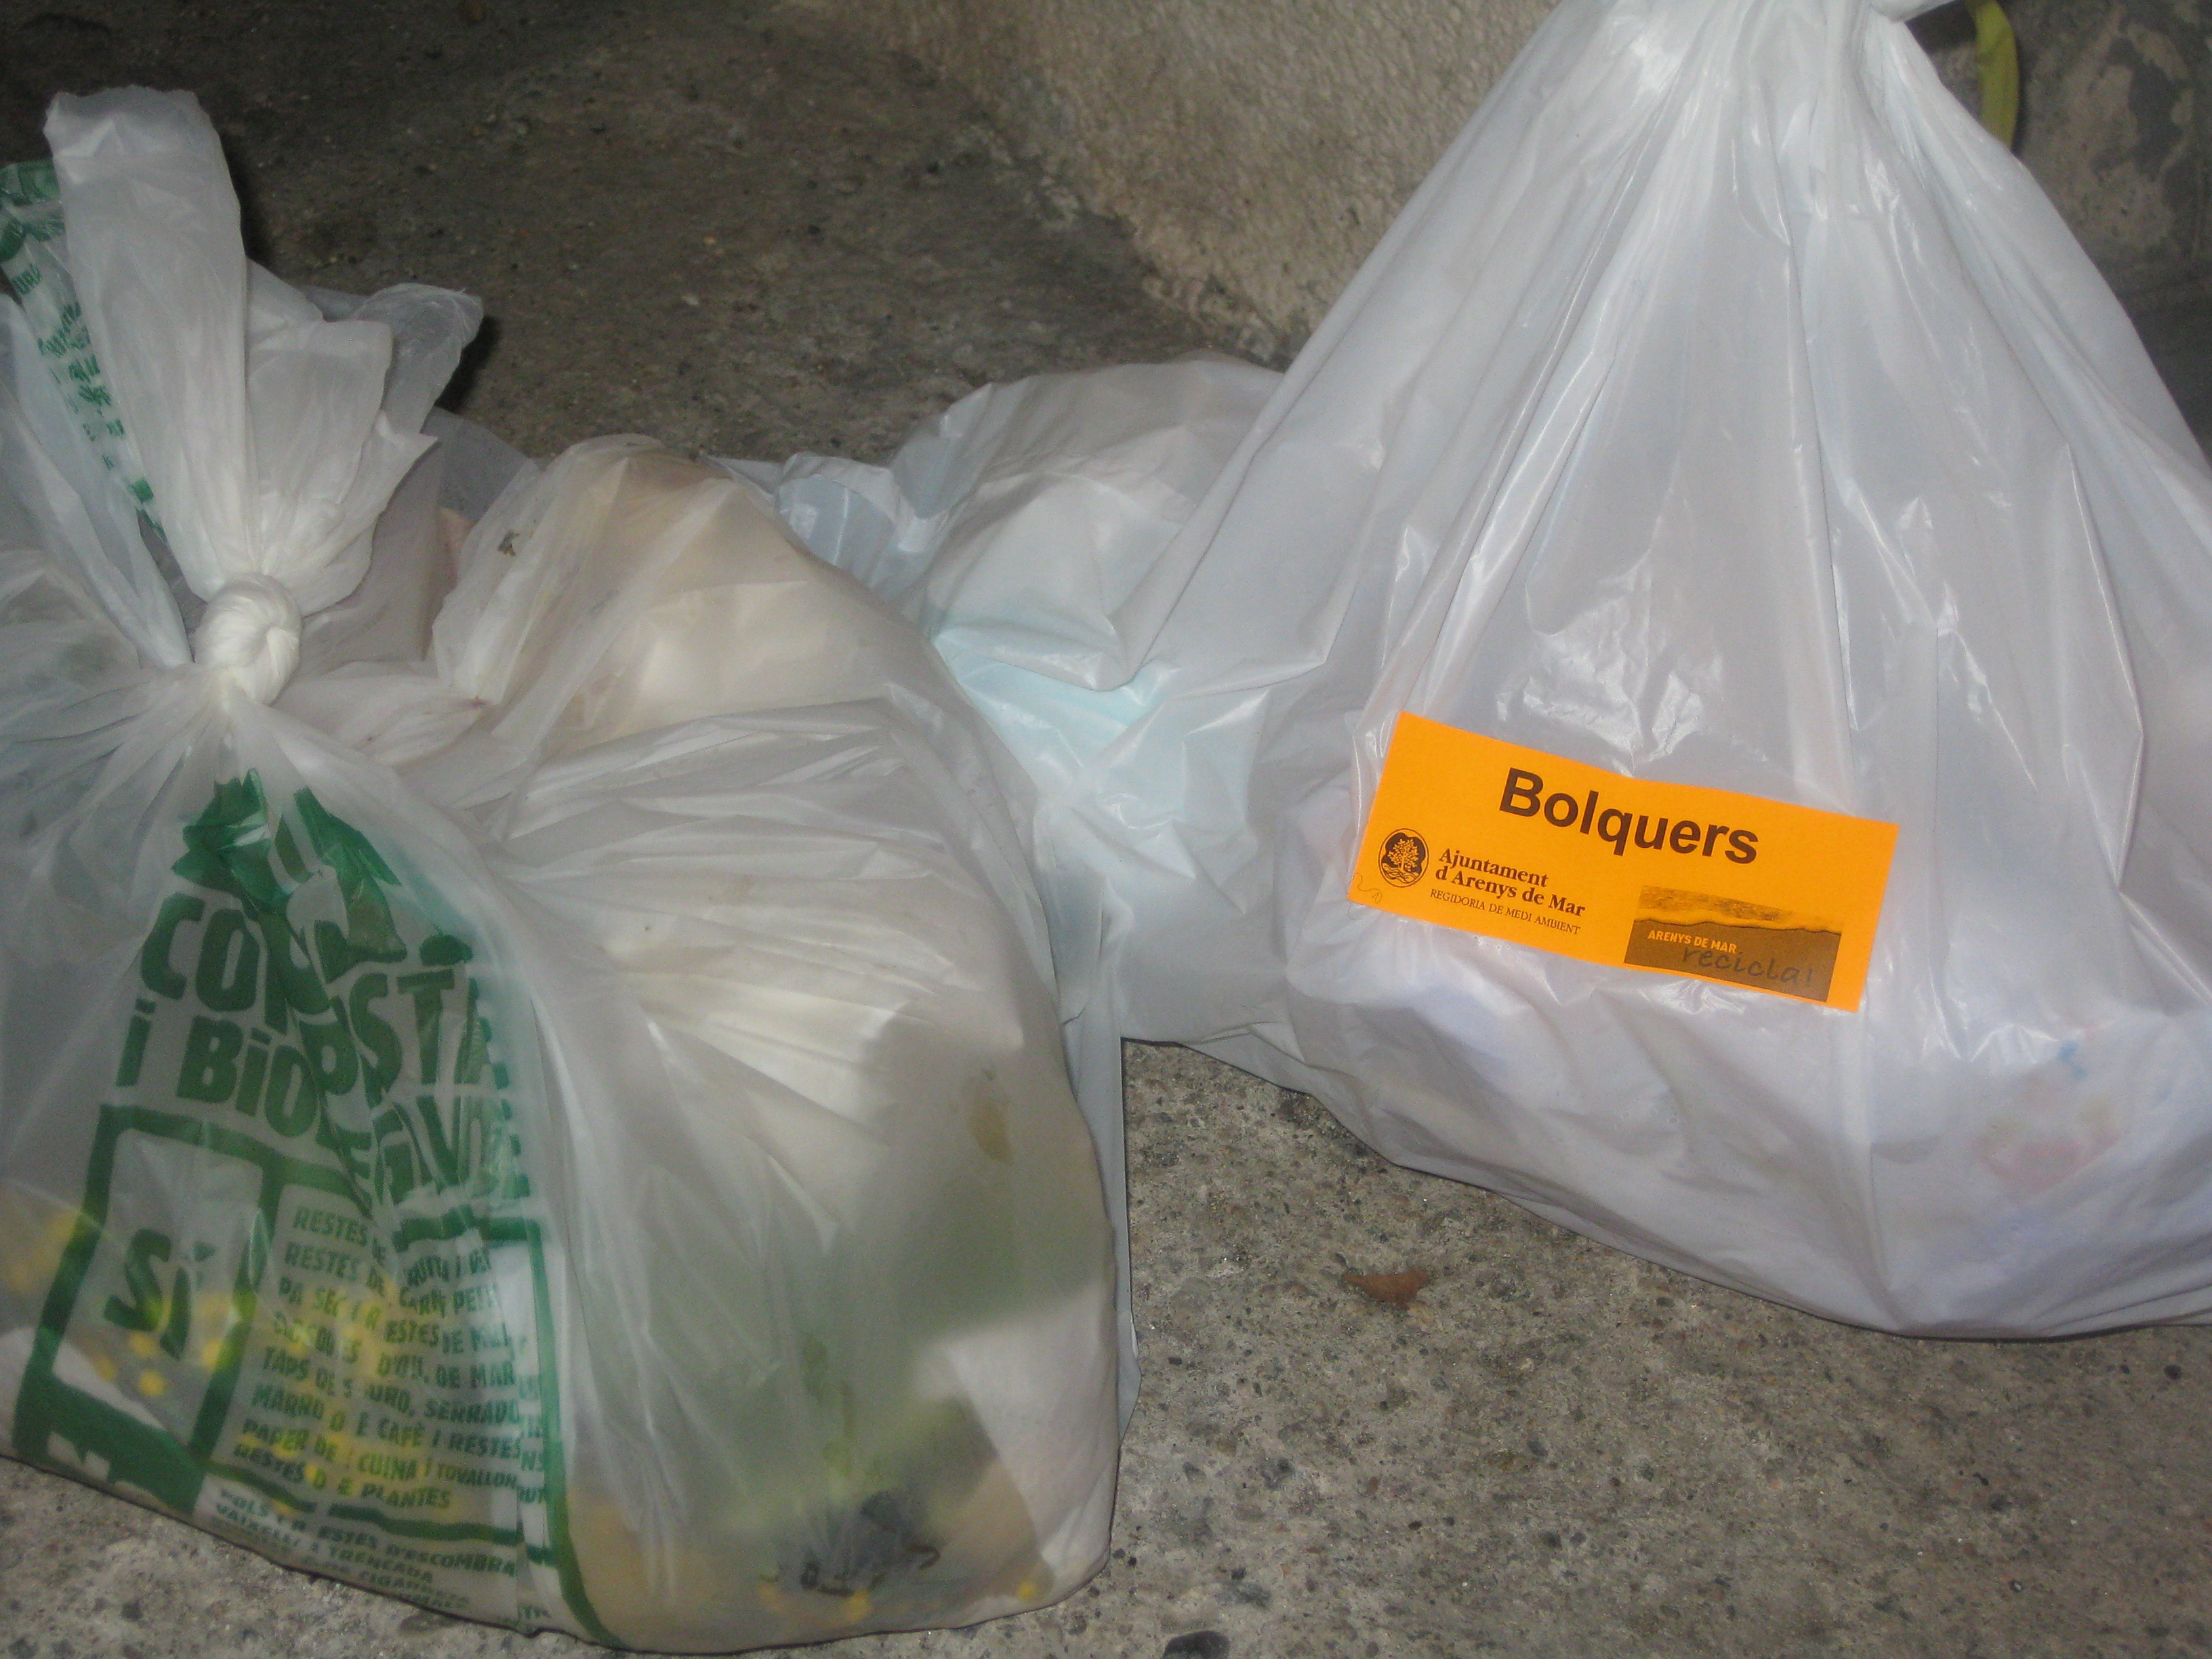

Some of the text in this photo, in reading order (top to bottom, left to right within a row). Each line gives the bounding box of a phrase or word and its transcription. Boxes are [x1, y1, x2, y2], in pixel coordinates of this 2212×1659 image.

[1499, 767, 1759, 865] Bolquers
[1439, 848, 1549, 888] Ajuntament
[1430, 888, 1582, 935] REGIDORIA DE MEDI AMBIENT
[1522, 887, 1544, 905] de
[1548, 893, 1586, 917] Mar
[1647, 929, 1738, 954] ARENYS DE MAR
